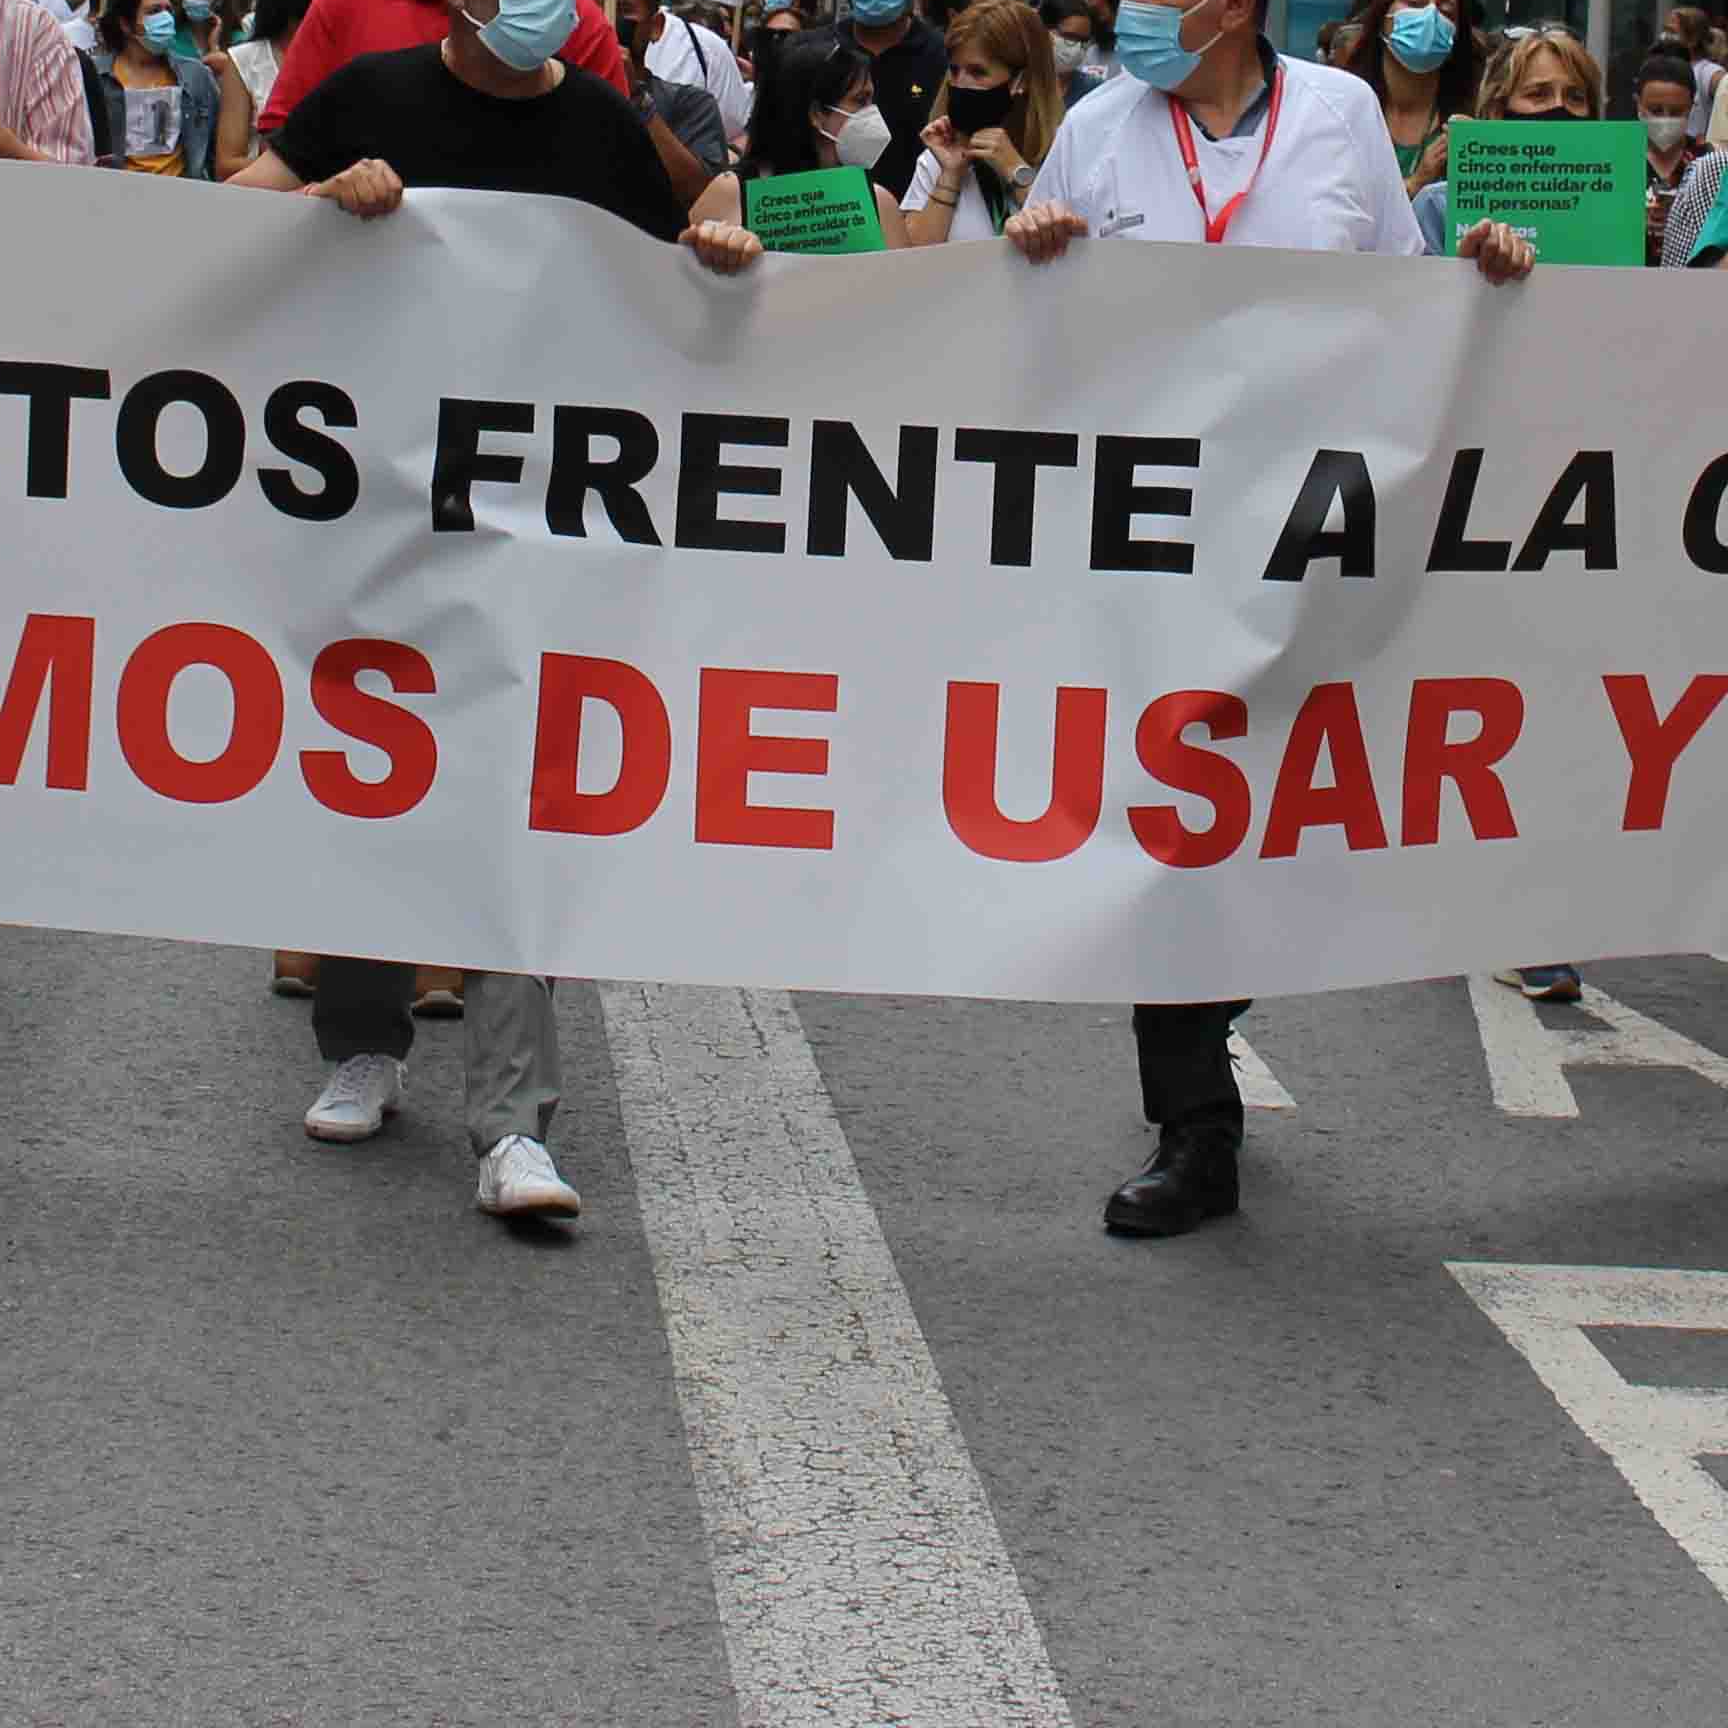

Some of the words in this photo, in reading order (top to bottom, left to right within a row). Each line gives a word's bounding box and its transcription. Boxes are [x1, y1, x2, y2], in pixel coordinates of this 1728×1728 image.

[1457, 141, 1521, 159] ¿Crees
[1522, 144, 1557, 160] que
[1457, 159, 1506, 174] cinco
[1509, 159, 1613, 175] enfermeras
[1456, 177, 1527, 194] pueden
[1530, 177, 1587, 193] cuidar
[1590, 177, 1614, 193] de
[755, 193, 800, 215] ¿Crees
[801, 190, 826, 207] que
[1455, 195, 1485, 210] mil
[1488, 195, 1581, 214] personas?
[754, 209, 794, 226] cinco
[431, 397, 1201, 575] FRENTE
[1262, 447, 1377, 582] A
[1424, 447, 1618, 574] LA
[528, 651, 839, 851] DE
[941, 677, 1525, 869] USAR
